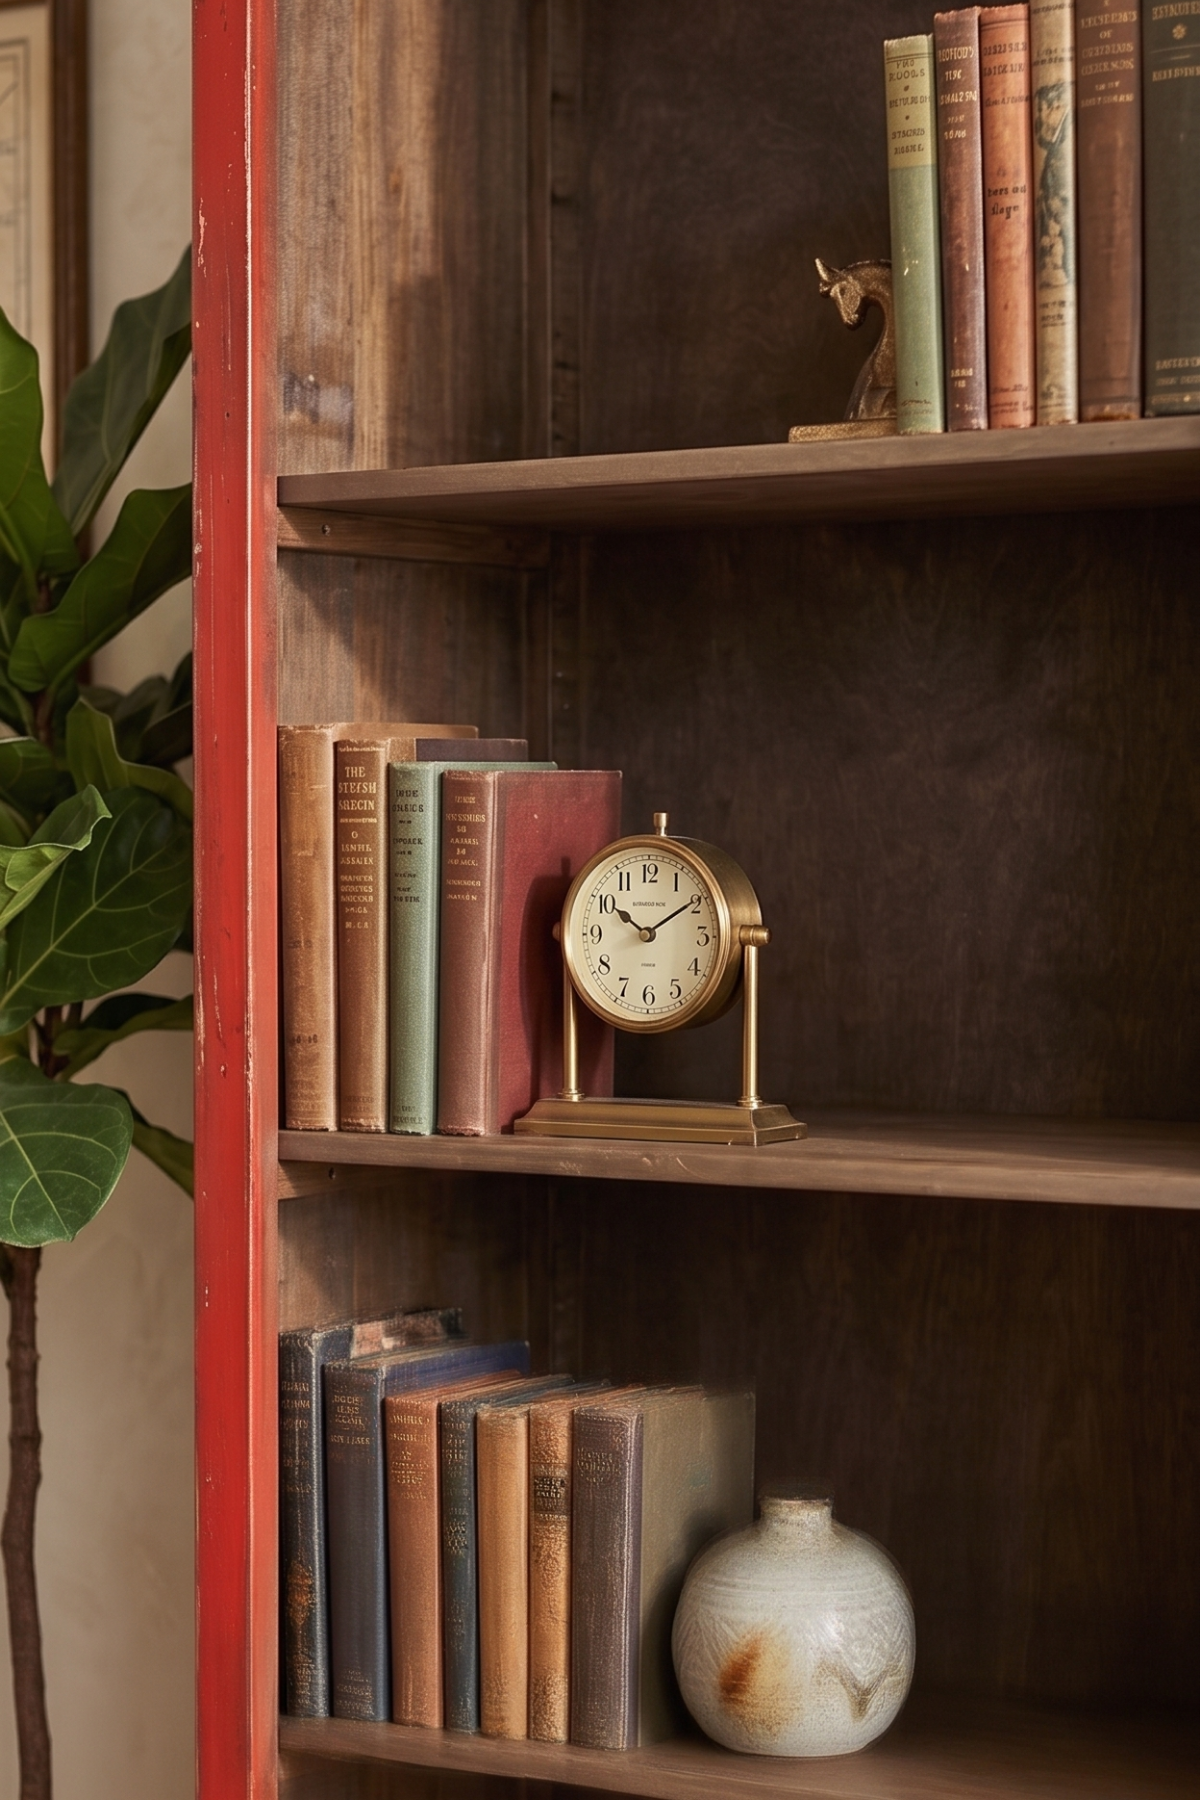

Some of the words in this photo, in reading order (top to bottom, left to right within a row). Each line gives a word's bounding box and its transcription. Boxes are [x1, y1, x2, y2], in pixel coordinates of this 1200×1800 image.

[345, 766, 366, 778] THE
[618, 871, 631, 891] 11
[642, 863, 658, 883] 12
[673, 872, 679, 892] 1
[599, 894, 616, 914] 10
[690, 894, 701, 914] 2
[590, 924, 603, 945] 9
[696, 926, 710, 947] 3
[598, 954, 611, 975] 8
[687, 957, 701, 976] 4
[618, 977, 630, 998] 7
[642, 985, 655, 1006] 6
[669, 979, 682, 999] 5
